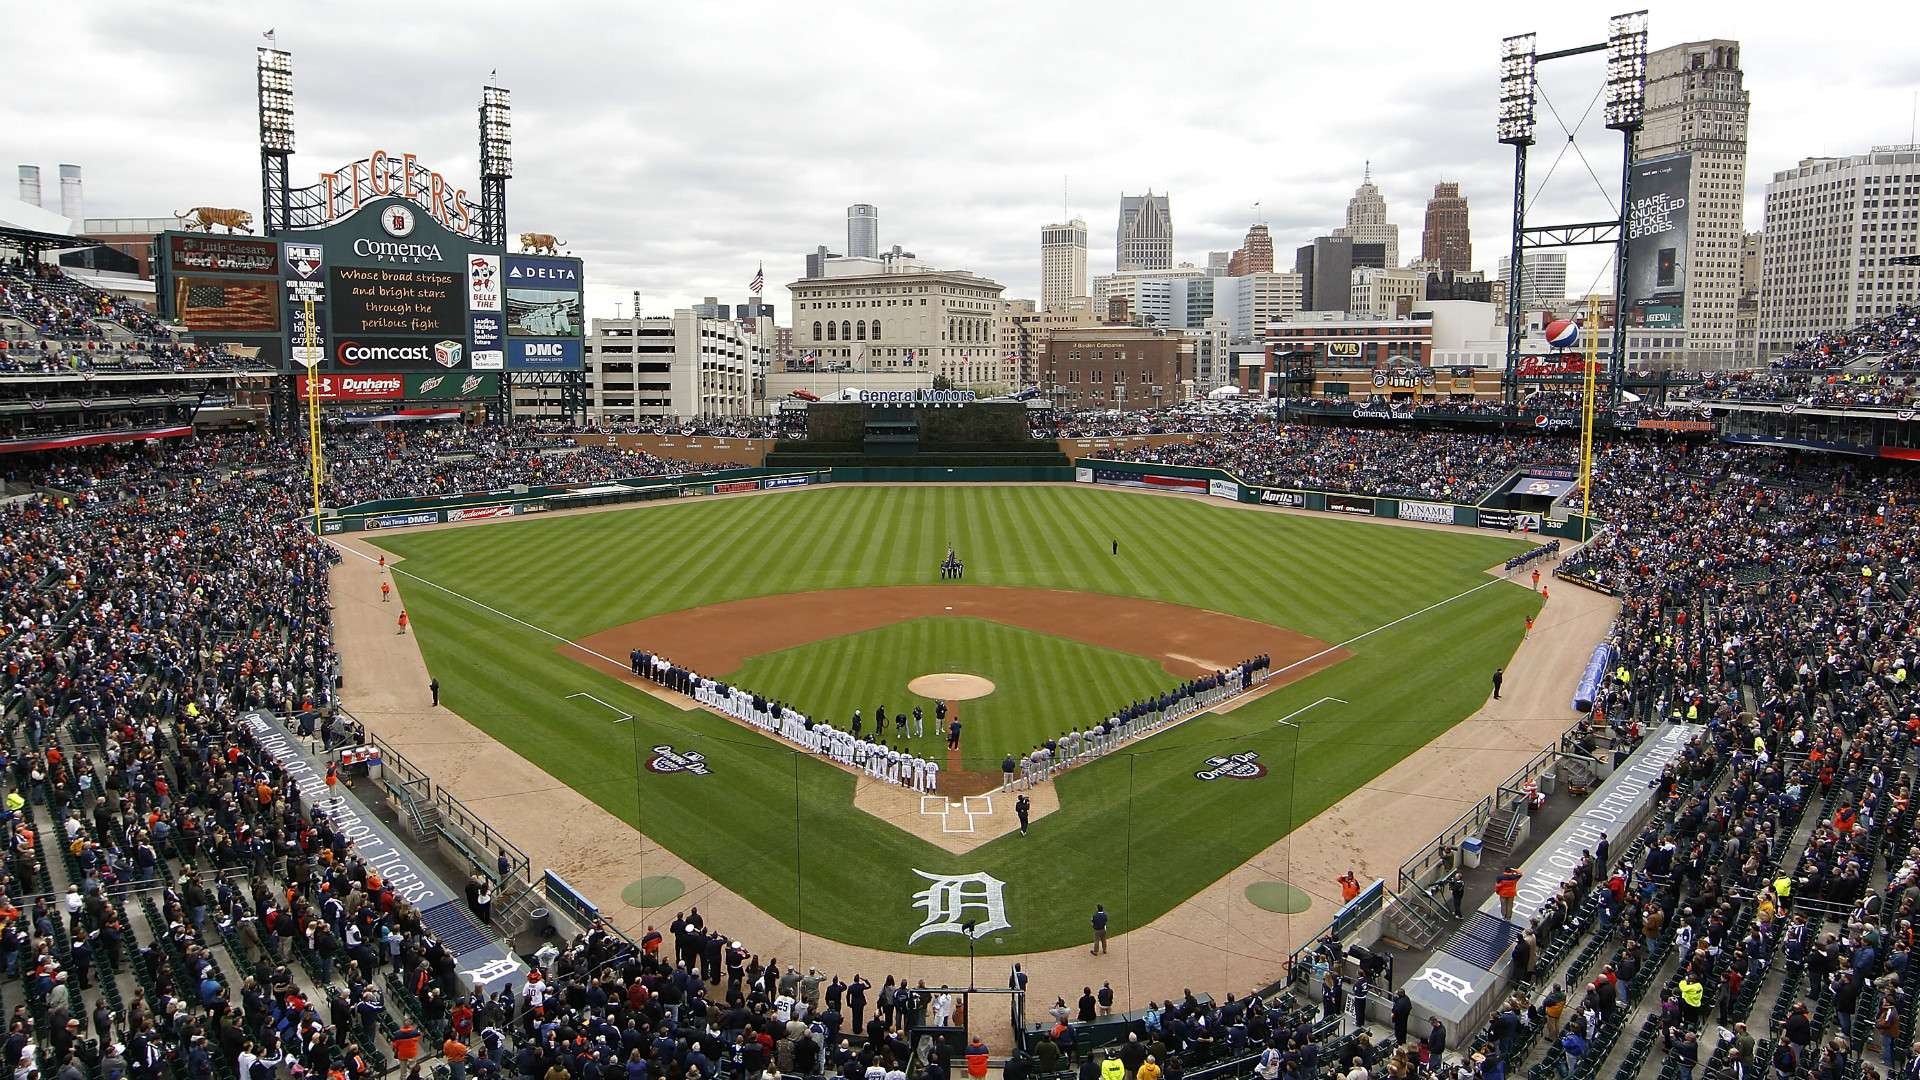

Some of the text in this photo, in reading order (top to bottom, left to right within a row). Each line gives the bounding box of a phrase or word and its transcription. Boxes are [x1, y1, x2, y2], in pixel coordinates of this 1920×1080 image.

[320, 150, 470, 232] TIGERS
[1637, 193, 1670, 209] BARE-
[1629, 211, 1670, 230] BUCKET
[1629, 220, 1676, 239] OF DOES.
[228, 243, 267, 255] Caesars
[288, 246, 321, 258] MLB
[377, 255, 421, 264] PARK
[340, 270, 453, 286] Whose broad stripes
[526, 267, 576, 280] DELTA
[299, 280, 325, 289] NATIONAL
[352, 285, 446, 300] and bright stars
[473, 293, 497, 301] BELLE
[366, 302, 432, 315] through the
[476, 300, 494, 308] TIRE
[360, 317, 441, 331] perilous fight
[524, 343, 563, 357] DMC
[1332, 342, 1358, 354] WJR
[342, 377, 401, 390] Dunham's
[1388, 376, 1420, 388] JUNGLE
[859, 389, 976, 402] General Motors
[1392, 411, 1414, 420] Bank
[1262, 490, 1287, 503] April
[453, 507, 499, 521] Budweiser
[1400, 501, 1452, 516] DYNAMIC
[258, 732, 435, 904] HOME OF THE DETROIT TIGERS
[1511, 744, 1679, 919] HOME OF THE DETROIT TIGERS
[777, 1000, 789, 1013] 25
